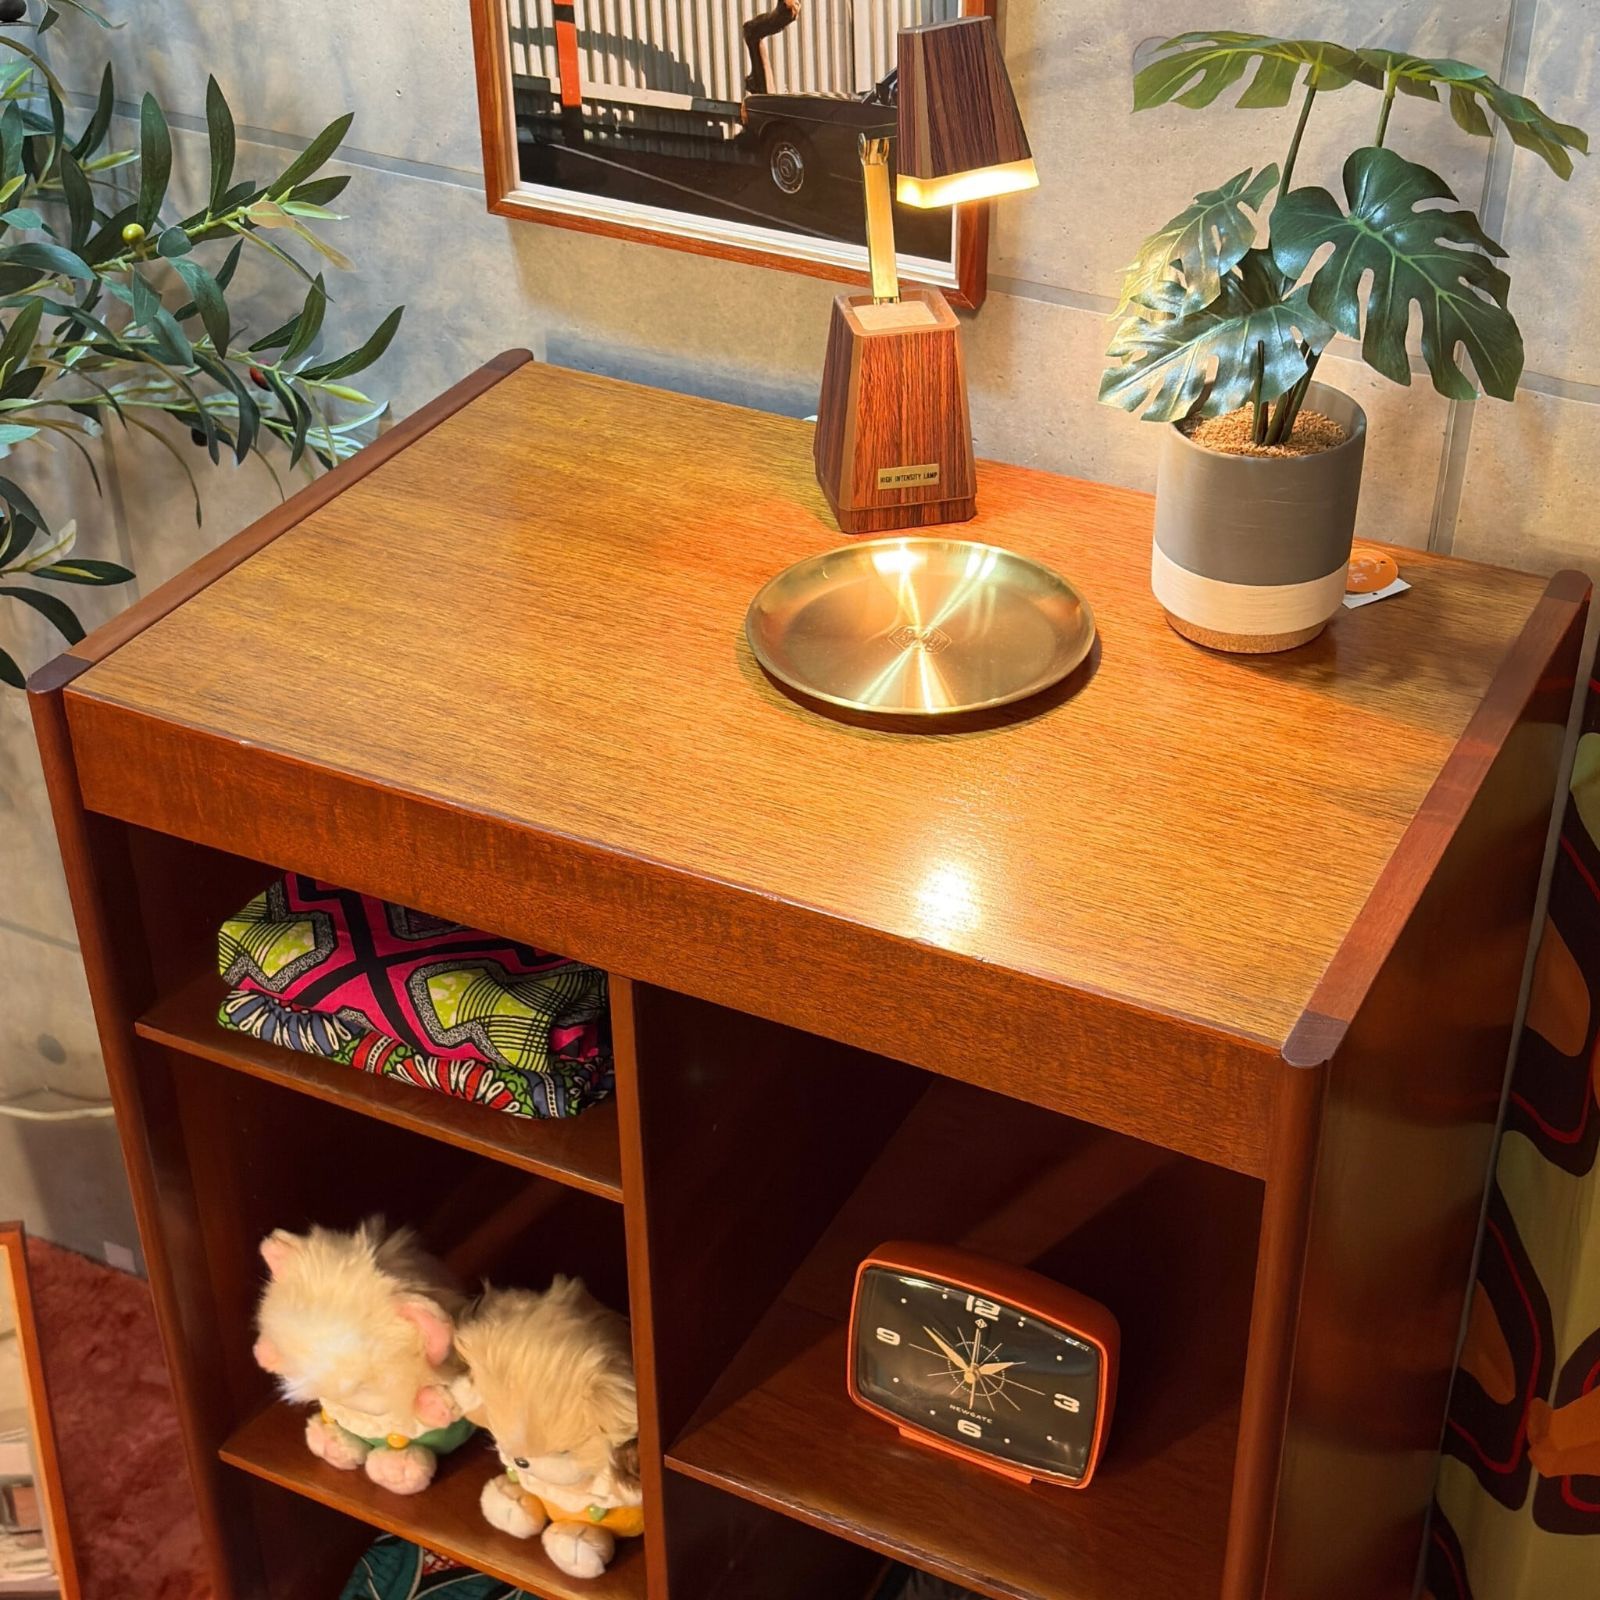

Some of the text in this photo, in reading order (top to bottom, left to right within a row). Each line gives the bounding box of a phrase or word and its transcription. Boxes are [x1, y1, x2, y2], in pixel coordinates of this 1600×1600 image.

[895, 473, 921, 482] INTENSITY
[924, 471, 938, 479] LAMP
[965, 1295, 1001, 1321] 12
[876, 1327, 901, 1346] 9
[1054, 1393, 1080, 1413] 3
[949, 1404, 993, 1424] NEWGATE
[957, 1419, 982, 1438] 6
